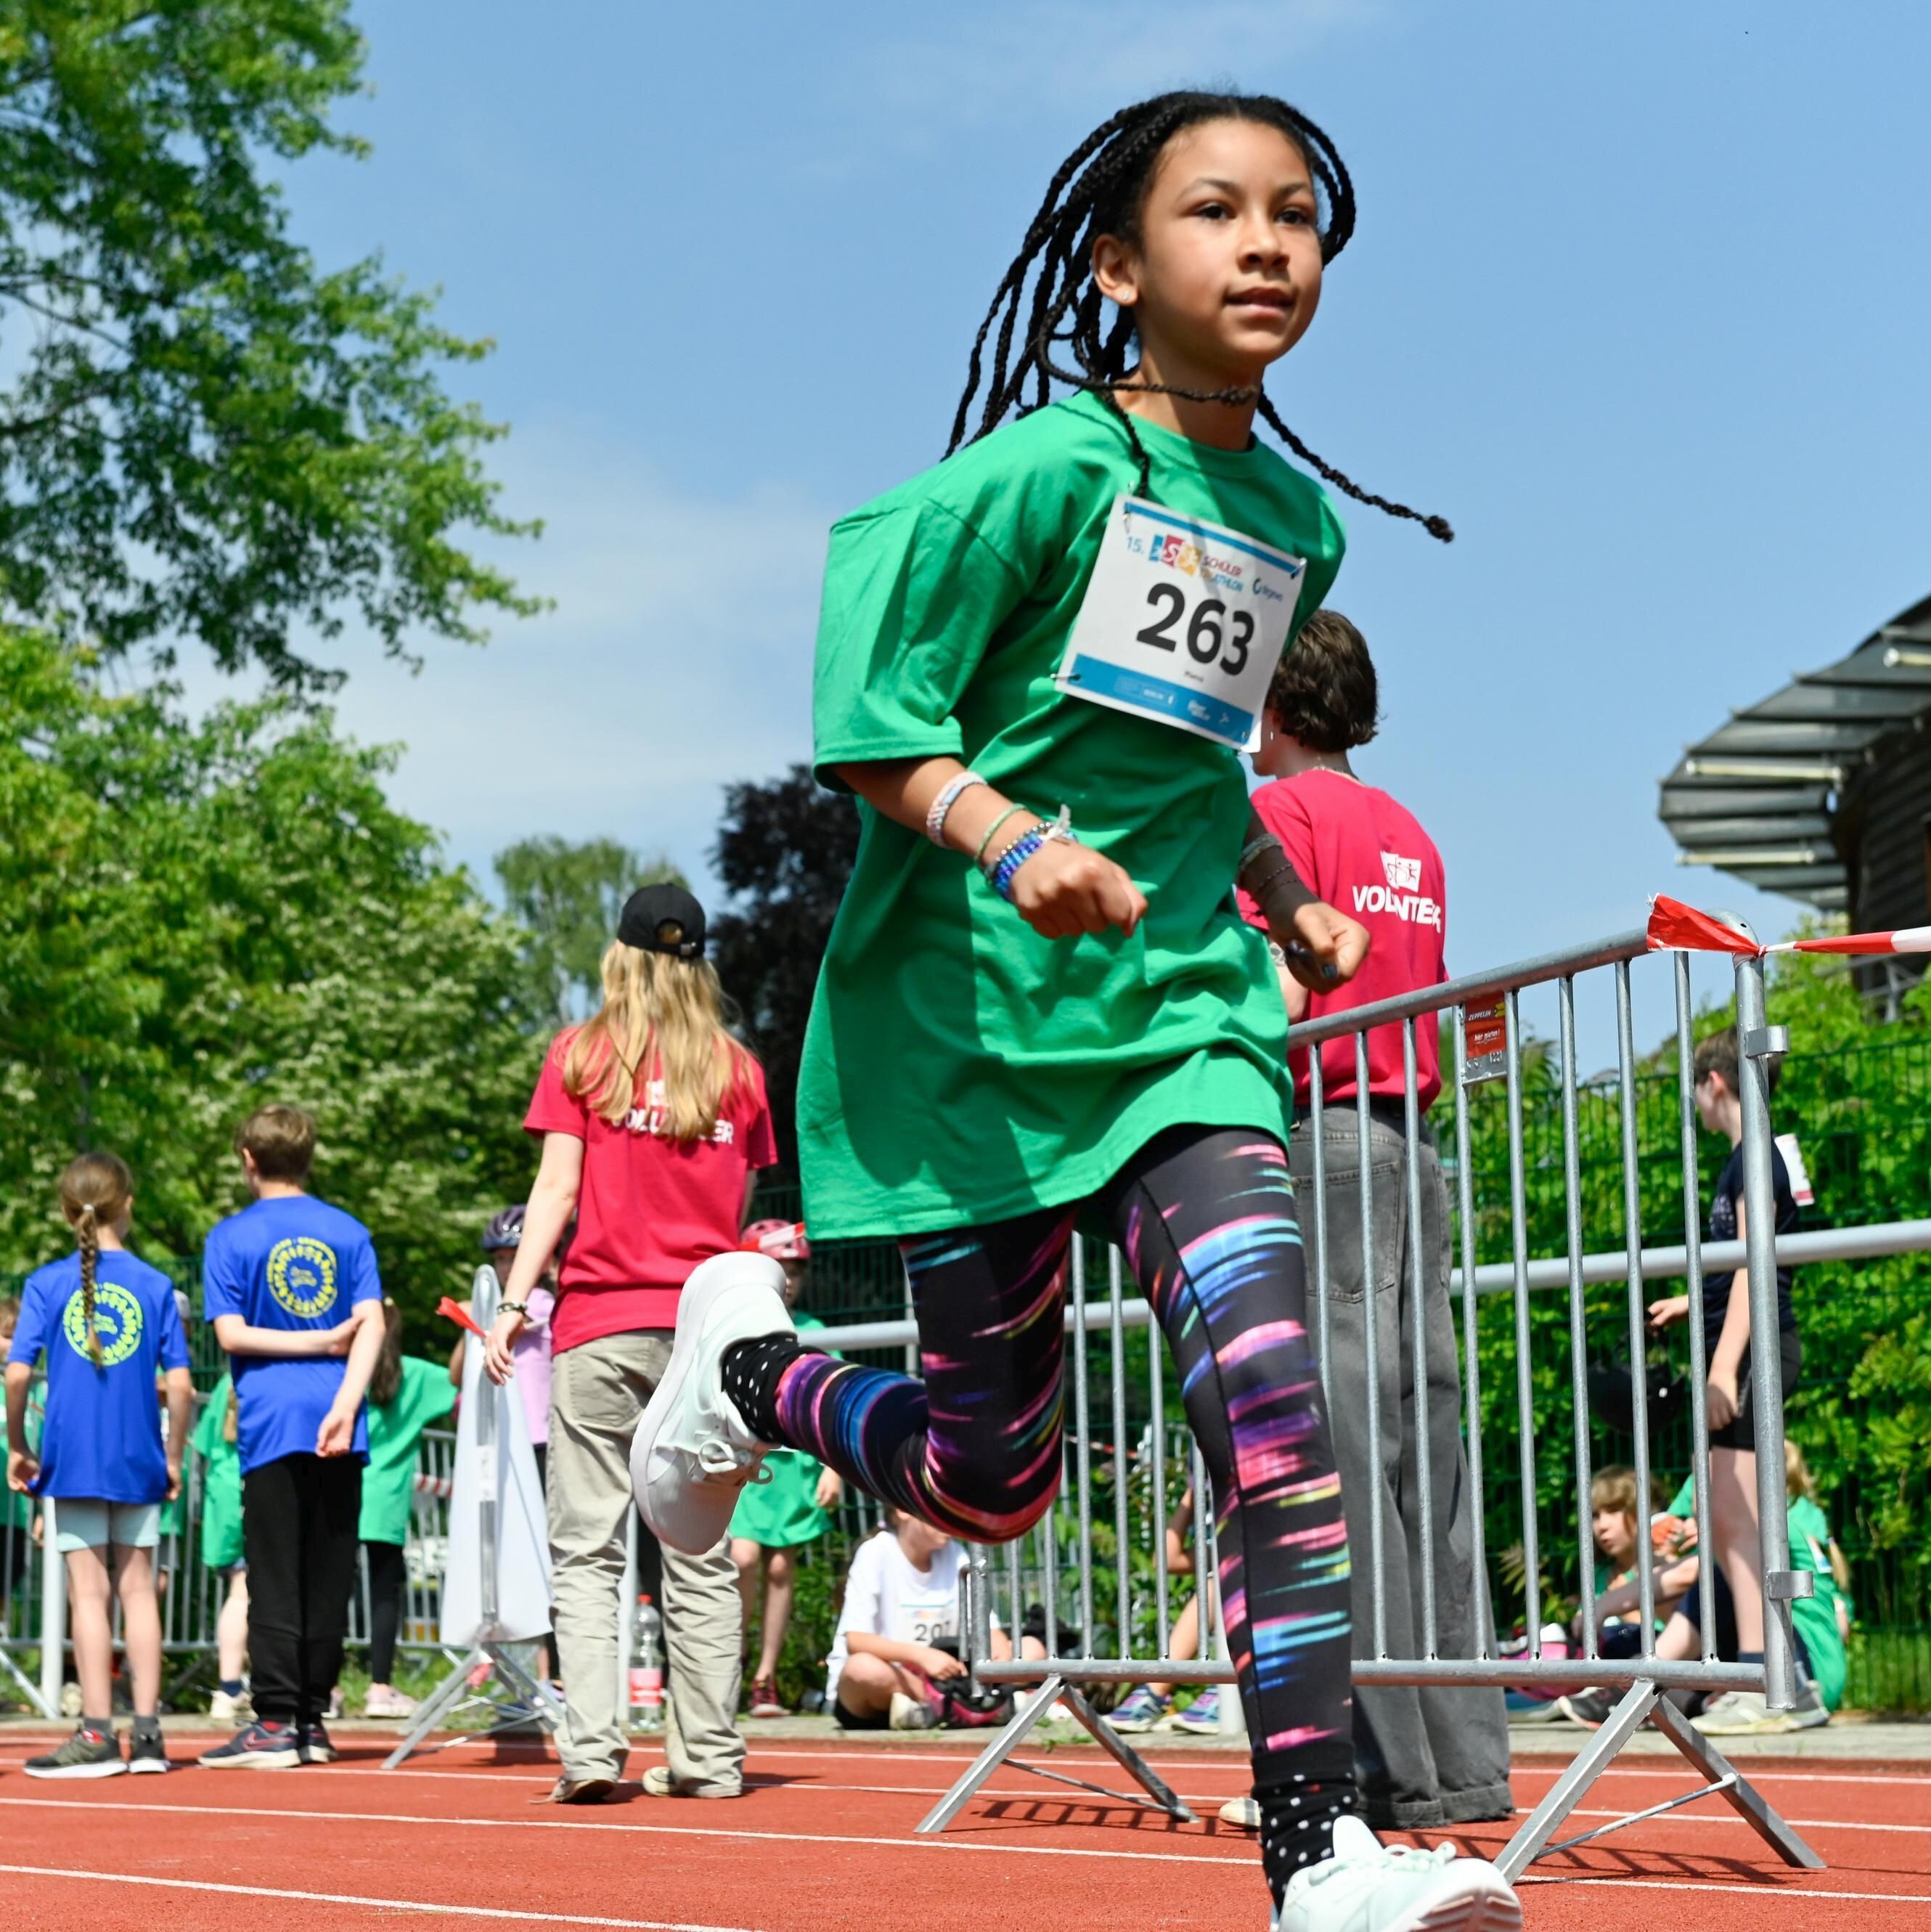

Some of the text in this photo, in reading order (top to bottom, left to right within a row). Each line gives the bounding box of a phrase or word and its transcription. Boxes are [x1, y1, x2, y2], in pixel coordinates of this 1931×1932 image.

[1136, 582, 1254, 676] 263
[1352, 885, 1441, 934] VOLNTER
[1468, 1010, 1492, 1022] ZEPPELIN
[915, 1620, 951, 1642] 20
